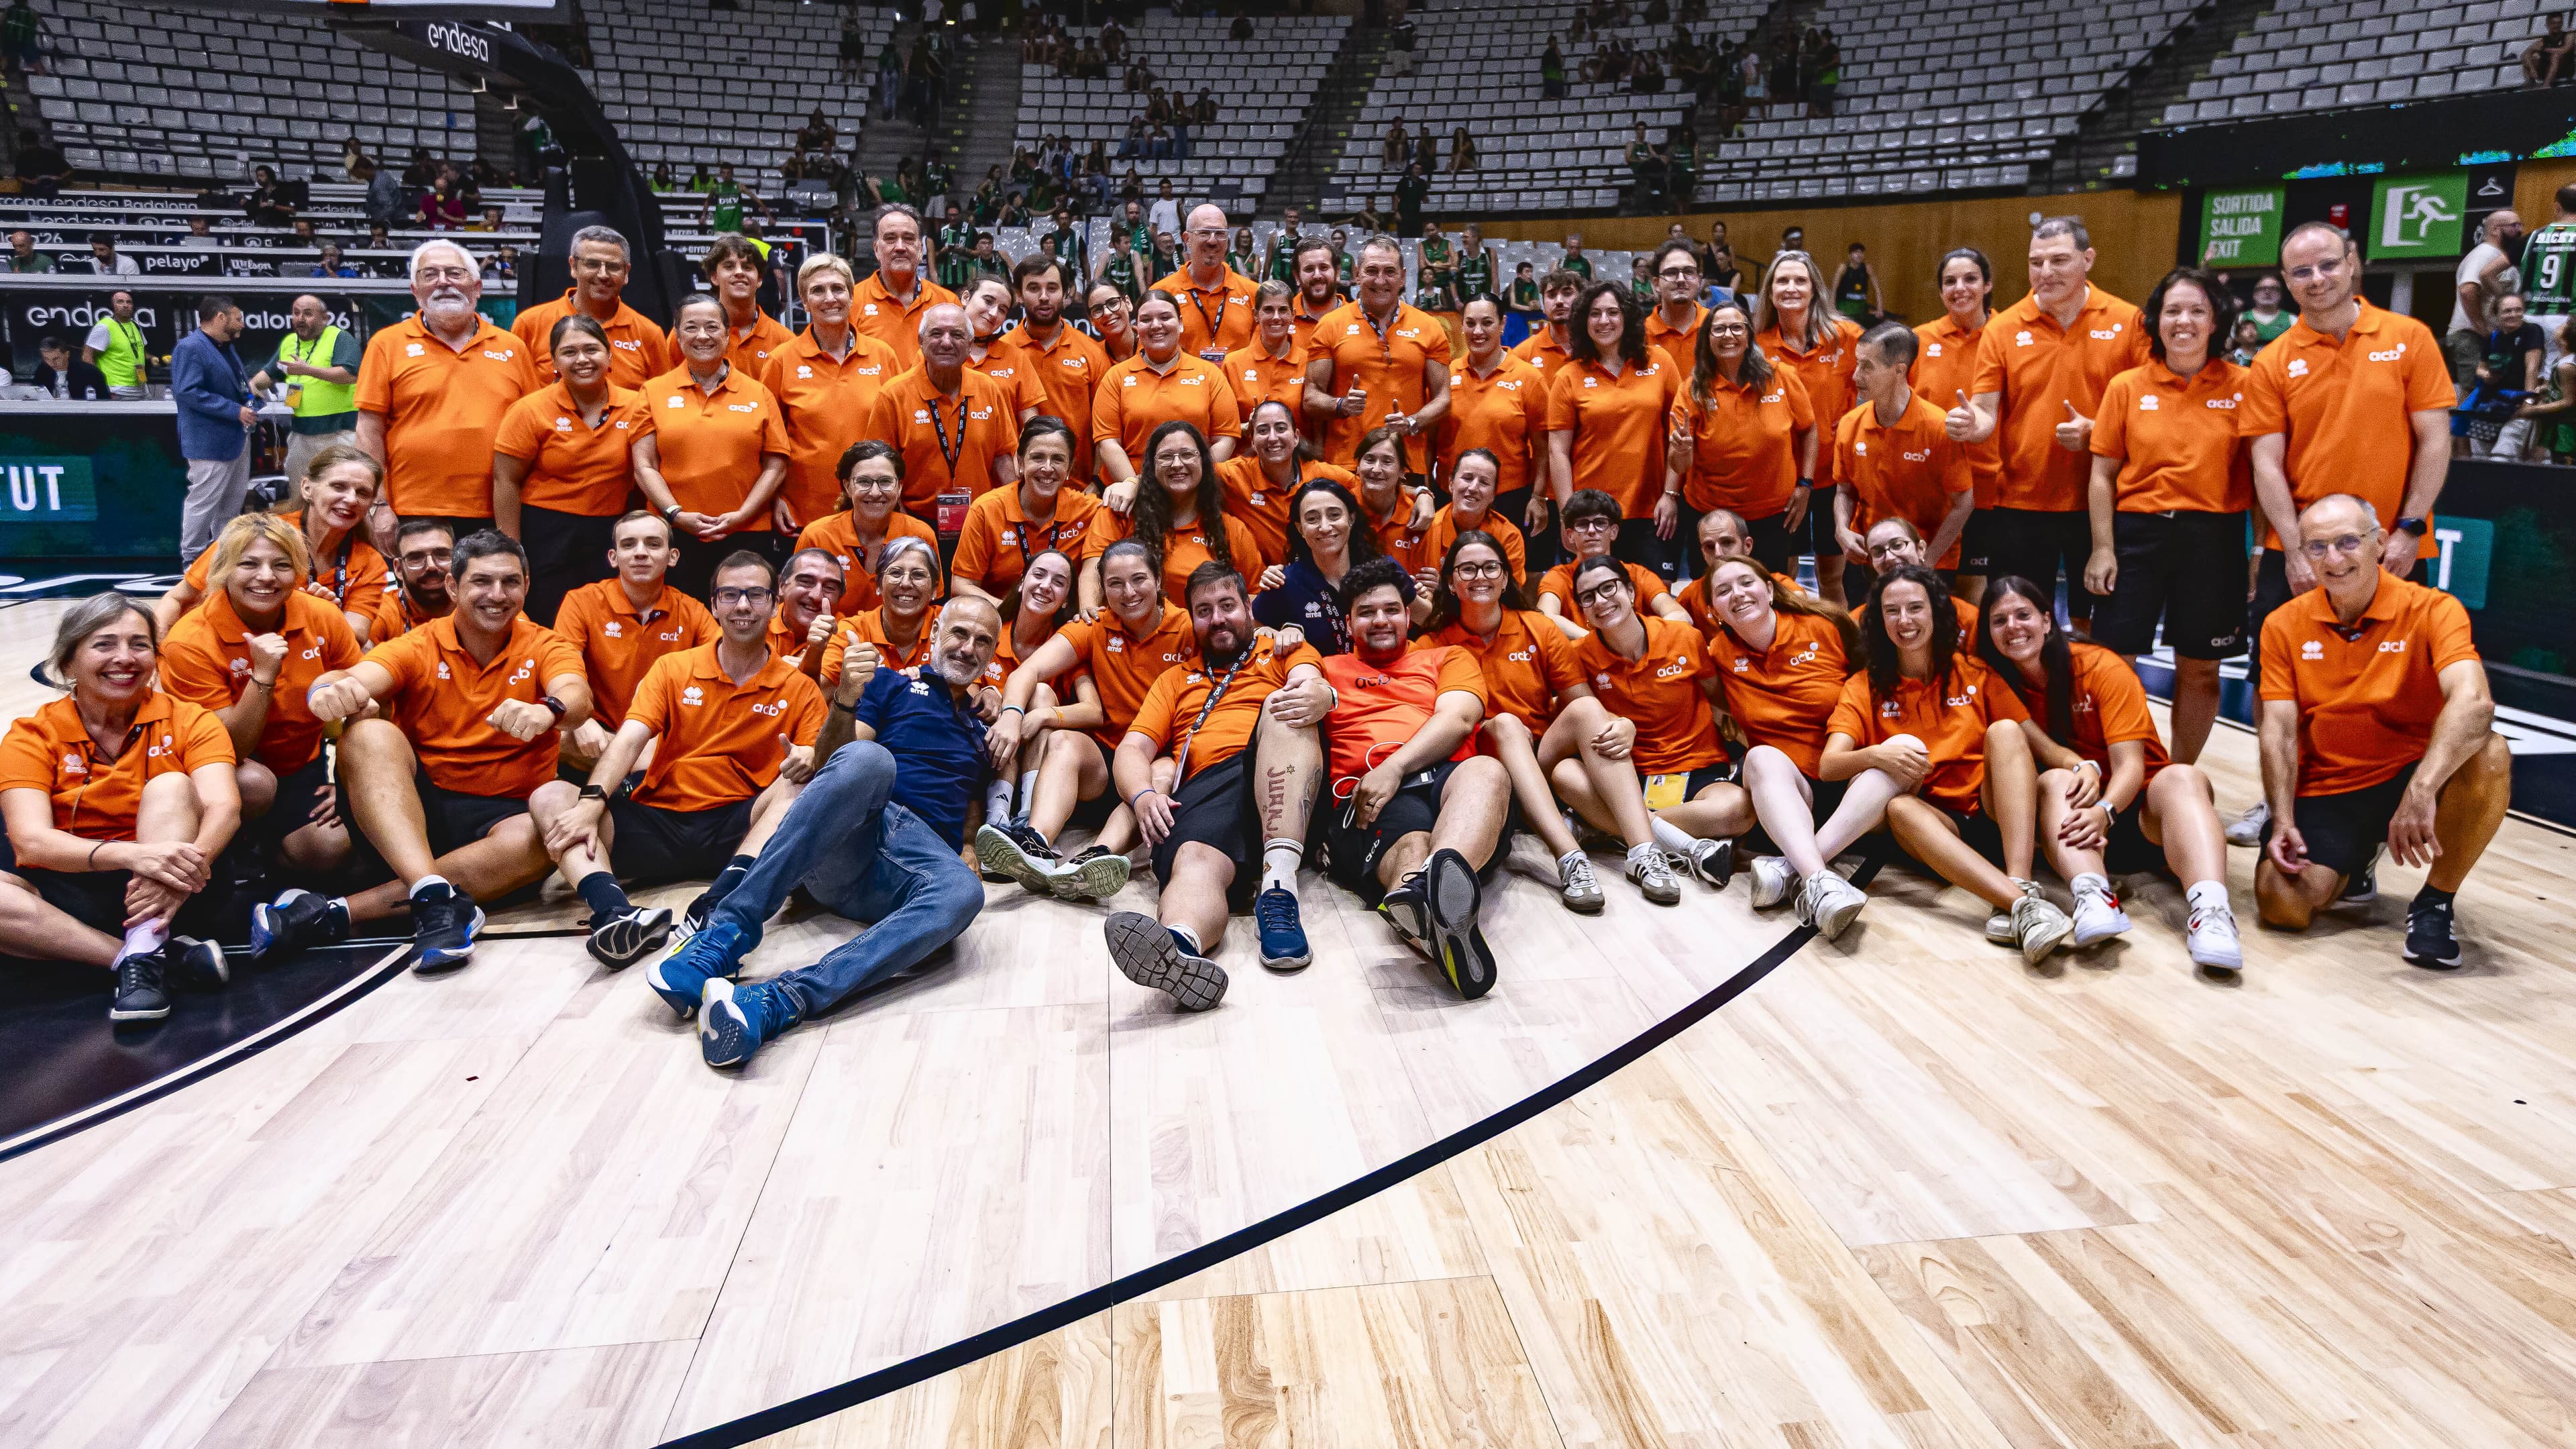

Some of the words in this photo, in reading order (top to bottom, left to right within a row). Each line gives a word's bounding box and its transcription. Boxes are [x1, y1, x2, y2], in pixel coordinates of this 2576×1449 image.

[428, 23, 488, 64] endesa
[2212, 193, 2274, 215] SORTIDA
[2210, 216, 2262, 236] SALIDA
[146, 255, 200, 272] pelayo
[2540, 254, 2561, 289] 9
[27, 301, 156, 328] enda
[1396, 329, 1415, 338] acb
[614, 339, 635, 351] acb
[484, 350, 508, 362] acb
[2368, 350, 2402, 362] acb
[1062, 359, 1081, 368] acb
[990, 370, 1008, 378] acb
[1635, 366, 1656, 376] acb
[1180, 378, 1199, 386] acb
[1497, 380, 1515, 391] acb
[728, 403, 751, 413] acb
[2206, 398, 2235, 409] acb
[970, 411, 989, 420] acb
[616, 421, 629, 429] ac
[1903, 450, 1925, 462] acb
[0, 466, 65, 511] UT
[1059, 528, 1079, 539] acb
[302, 647, 321, 660] ac
[1508, 650, 1532, 661] acb
[1790, 650, 1815, 666] acb
[508, 666, 531, 686] cb
[1657, 663, 1682, 678] acb
[1355, 674, 1391, 689] acb
[1947, 693, 1972, 706] acb
[752, 703, 778, 716] acb
[1365, 839, 1381, 863] acb
